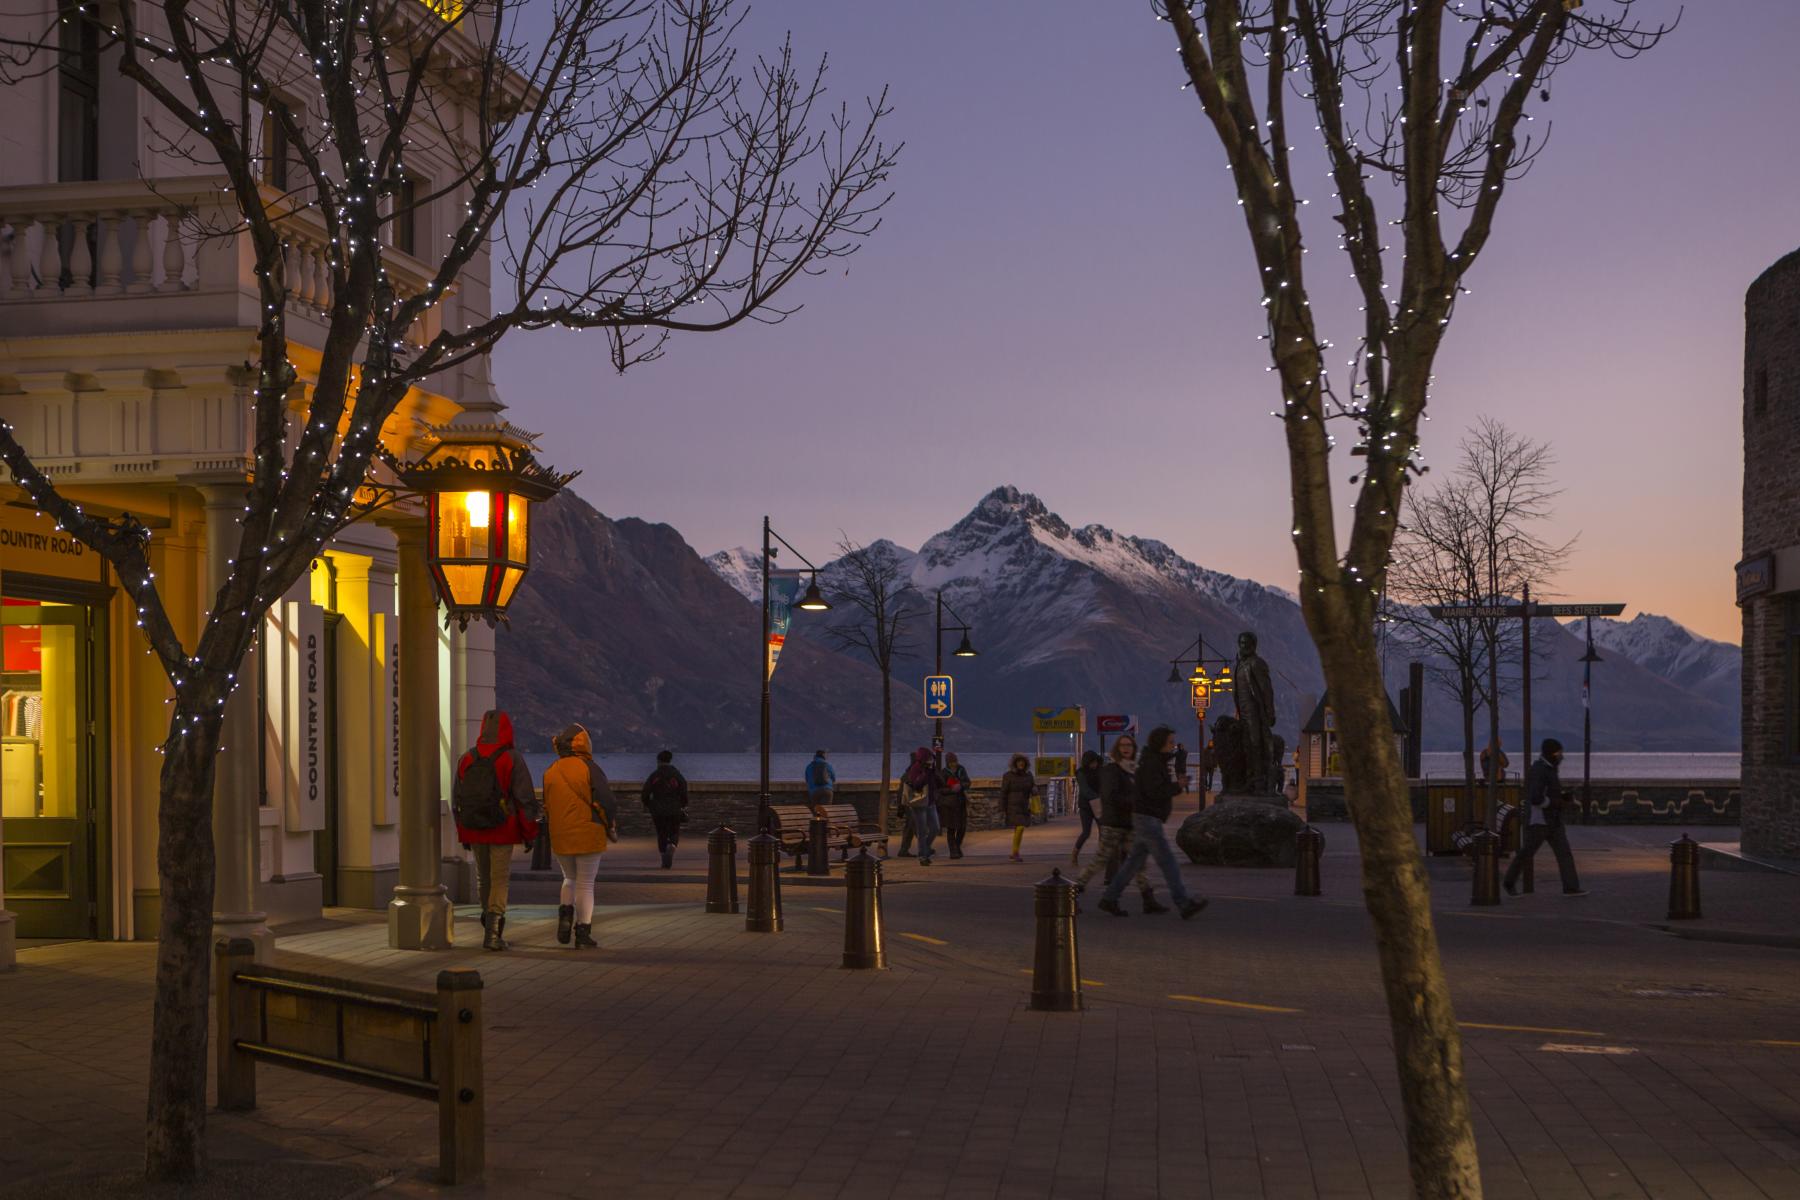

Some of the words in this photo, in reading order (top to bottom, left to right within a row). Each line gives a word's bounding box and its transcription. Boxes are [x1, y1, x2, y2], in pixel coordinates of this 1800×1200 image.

[0, 529, 48, 550] OUNTRY
[51, 538, 83, 556] ROAD
[1442, 607, 1473, 617] MARINE
[1476, 607, 1507, 616] PARADE
[1575, 606, 1603, 615] STREET
[307, 634, 317, 693] ROAD
[308, 697, 318, 801] COUNTRY
